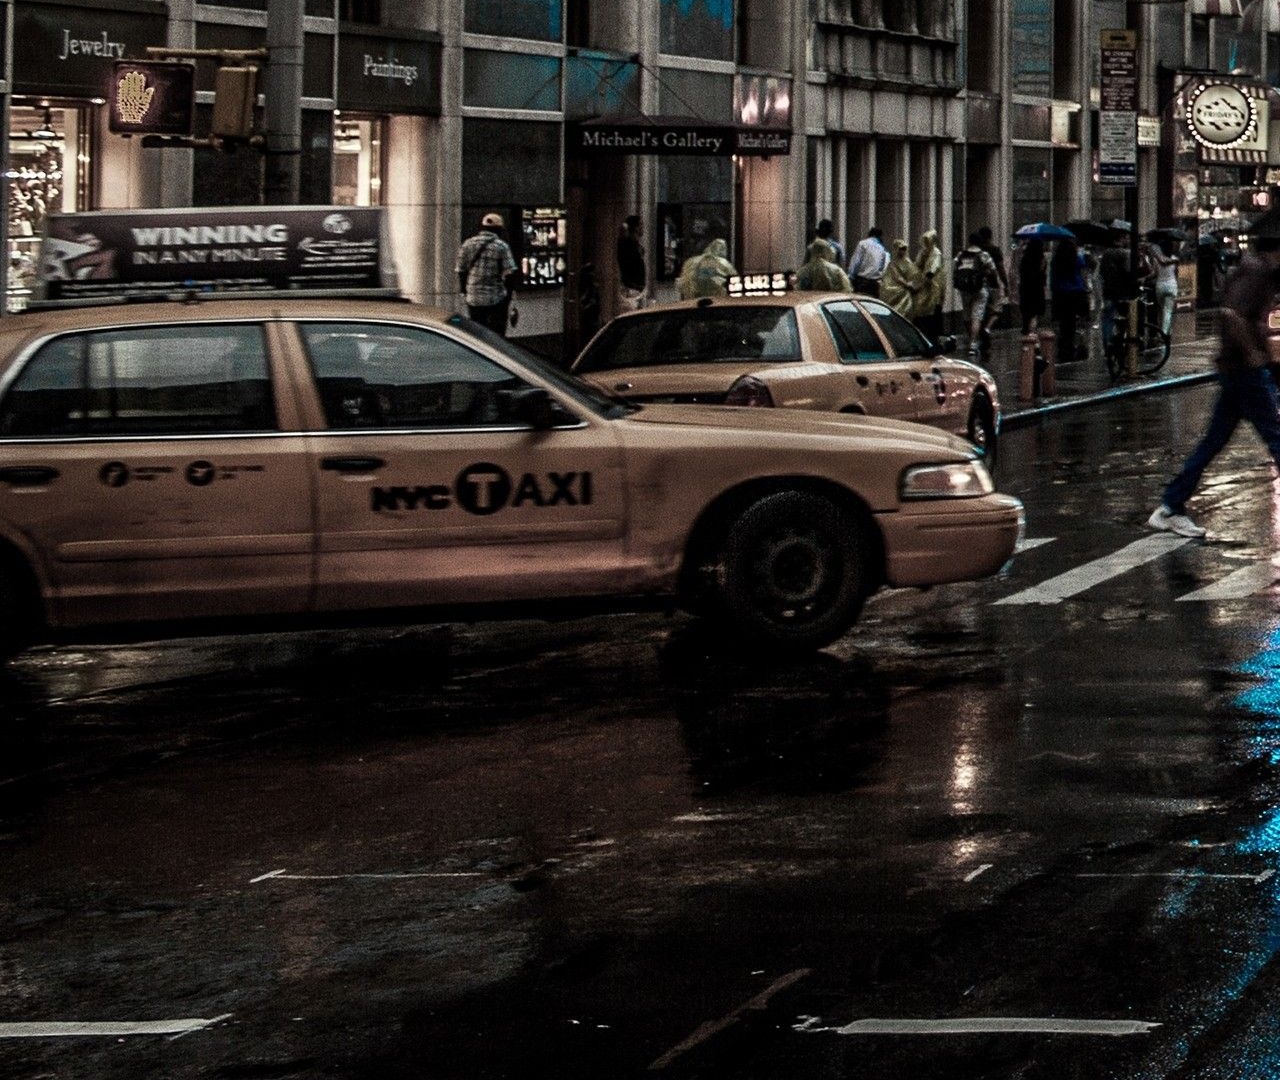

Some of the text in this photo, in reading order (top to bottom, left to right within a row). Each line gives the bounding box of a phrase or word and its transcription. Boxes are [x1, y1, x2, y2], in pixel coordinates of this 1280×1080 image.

[59, 29, 126, 61] Jewelry
[363, 54, 418, 86] Paintings
[582, 131, 723, 152] Michael's Gallery
[130, 224, 288, 246] WINNING
[132, 247, 288, 265] IN ANY MINUTE
[371, 466, 593, 513] NYC TAXI
